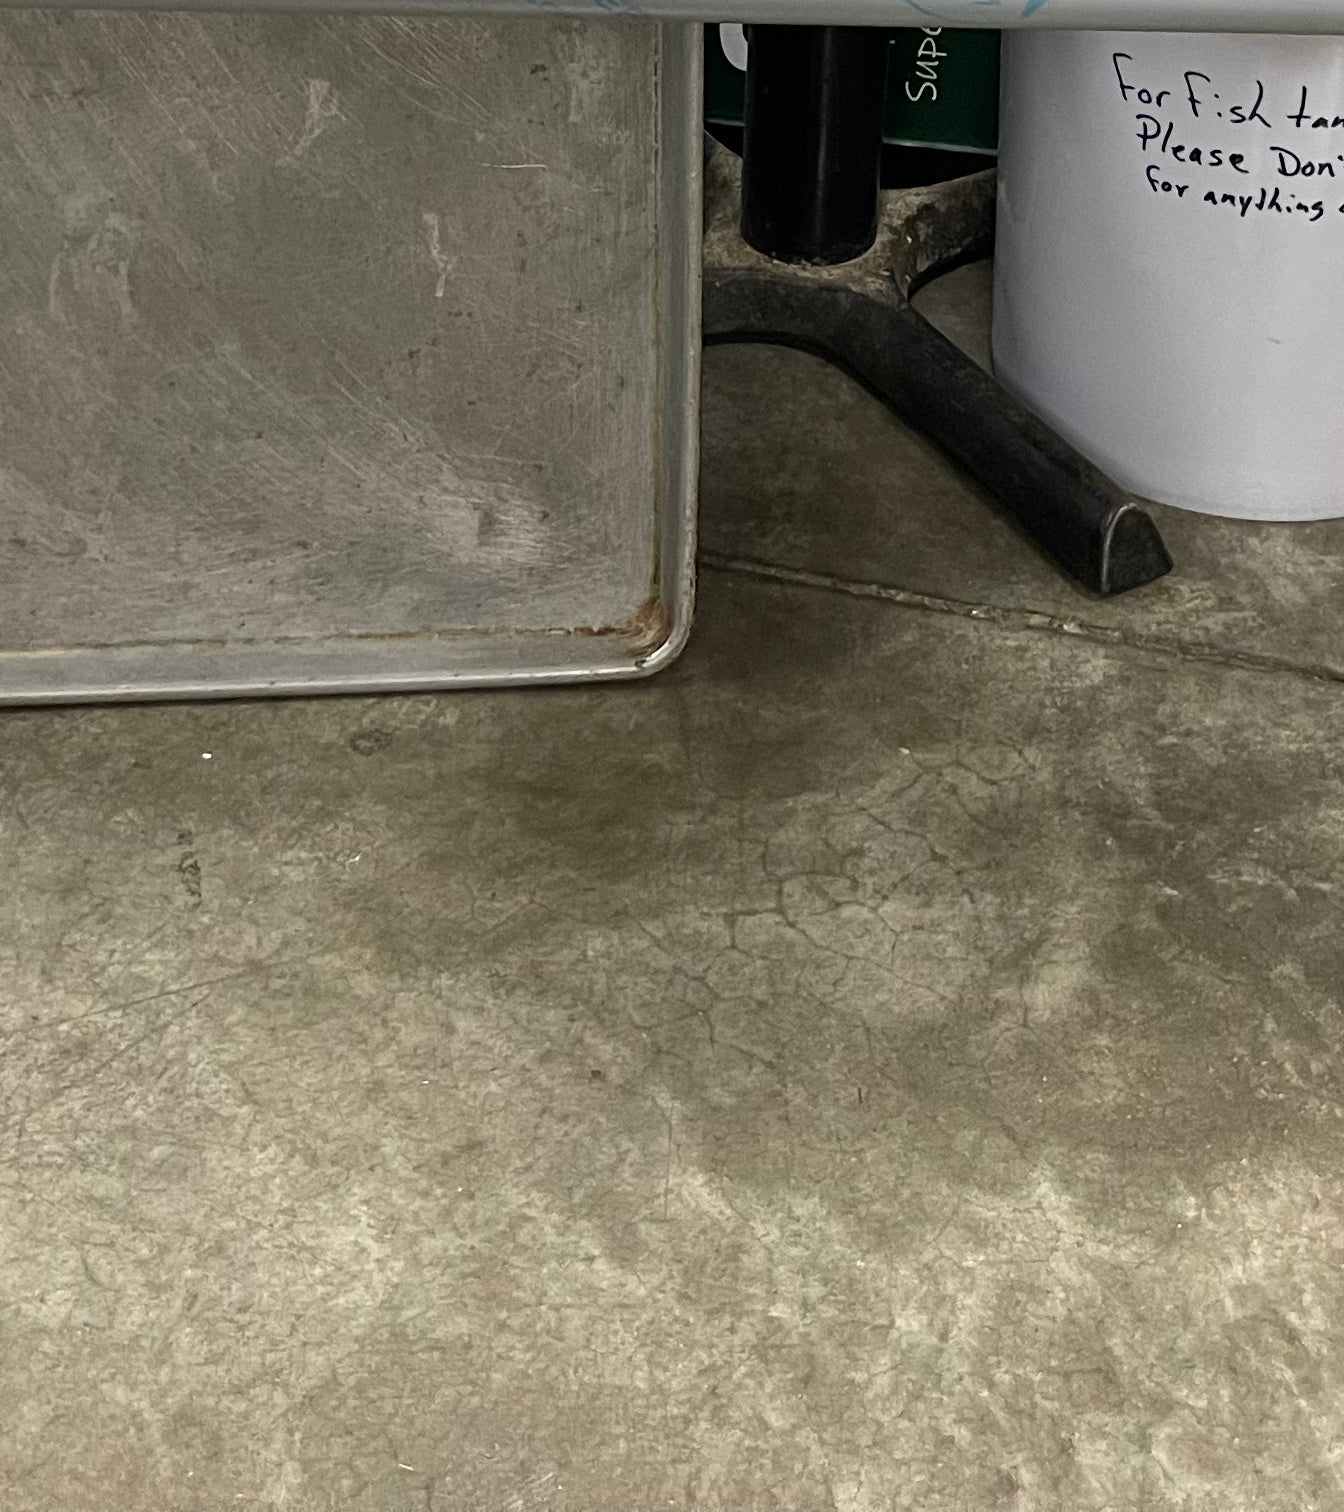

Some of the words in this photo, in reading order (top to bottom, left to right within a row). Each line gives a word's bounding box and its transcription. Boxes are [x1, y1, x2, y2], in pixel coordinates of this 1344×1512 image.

[1111, 52, 1172, 108] For
[1183, 71, 1272, 129] Fish
[1135, 112, 1251, 175] Please
[1144, 164, 1191, 199] for
[1202, 185, 1325, 222] anything
